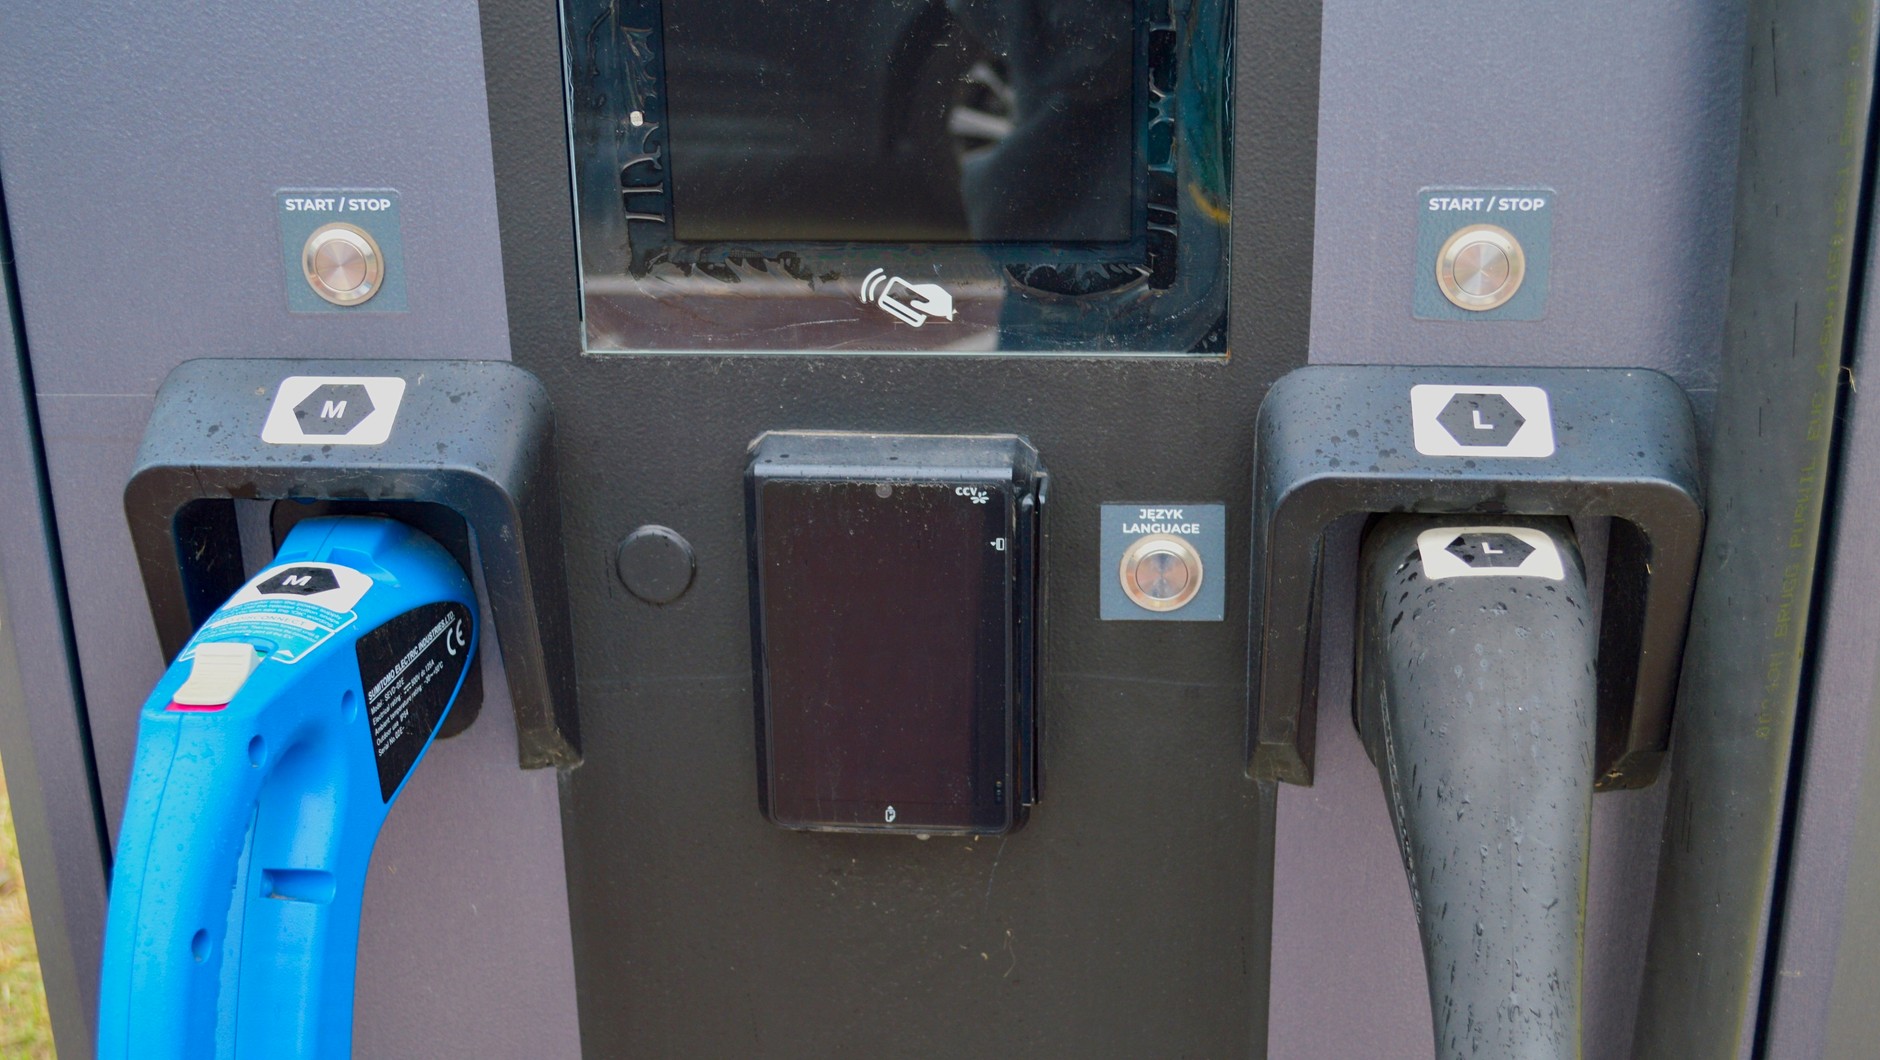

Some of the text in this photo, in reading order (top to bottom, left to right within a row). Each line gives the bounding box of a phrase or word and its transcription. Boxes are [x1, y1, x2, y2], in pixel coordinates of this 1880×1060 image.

[285, 197, 391, 212] START / STOP
[1429, 196, 1545, 212] START / STOP
[320, 400, 348, 418] M
[1472, 410, 1494, 429] L
[955, 487, 978, 496] CCV
[1139, 509, 1183, 522] JĘZYK
[1122, 523, 1200, 534] LANGUAGE
[1481, 542, 1504, 554] L
[282, 575, 312, 586] M
[394, 645, 419, 675] ELECTRIC
